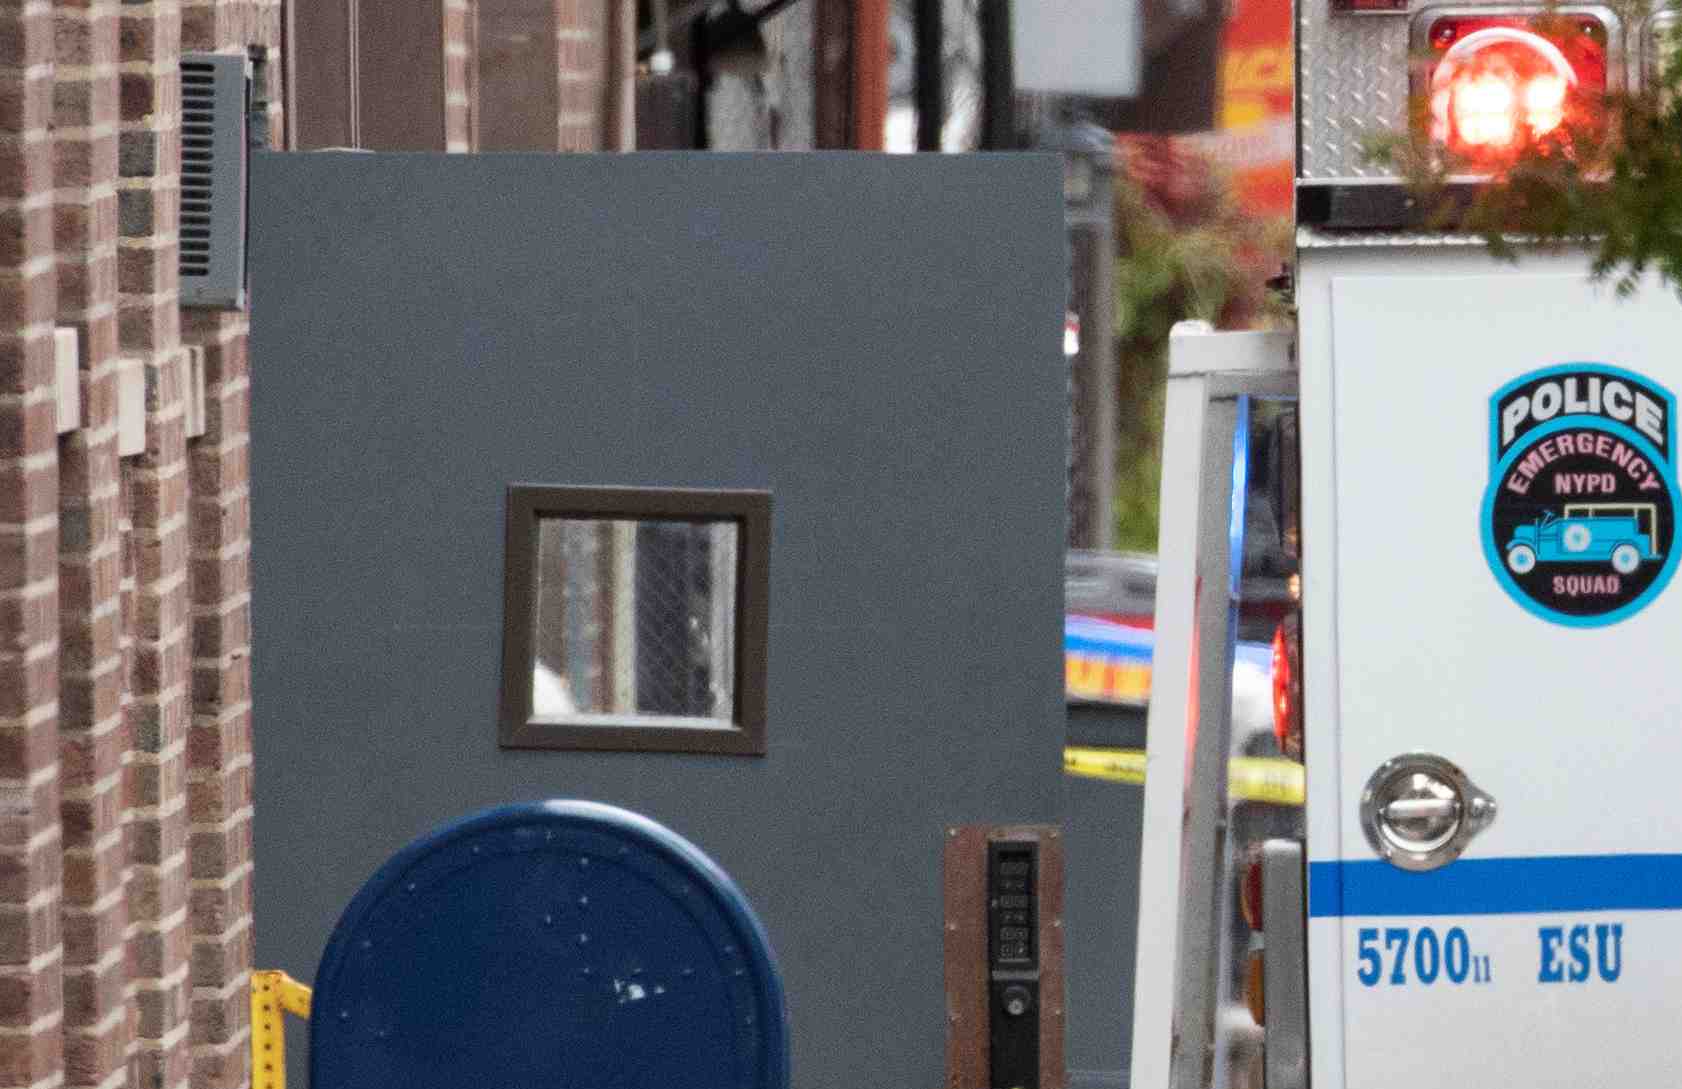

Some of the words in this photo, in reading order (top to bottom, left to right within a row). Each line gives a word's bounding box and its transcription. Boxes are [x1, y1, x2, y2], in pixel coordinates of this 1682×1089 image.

[1502, 376, 1664, 448] POLICE
[1505, 432, 1661, 495] EMERGENCY
[1554, 473, 1617, 494] NYPD
[1552, 575, 1621, 597] SQUAD
[1537, 922, 1624, 984] ESU
